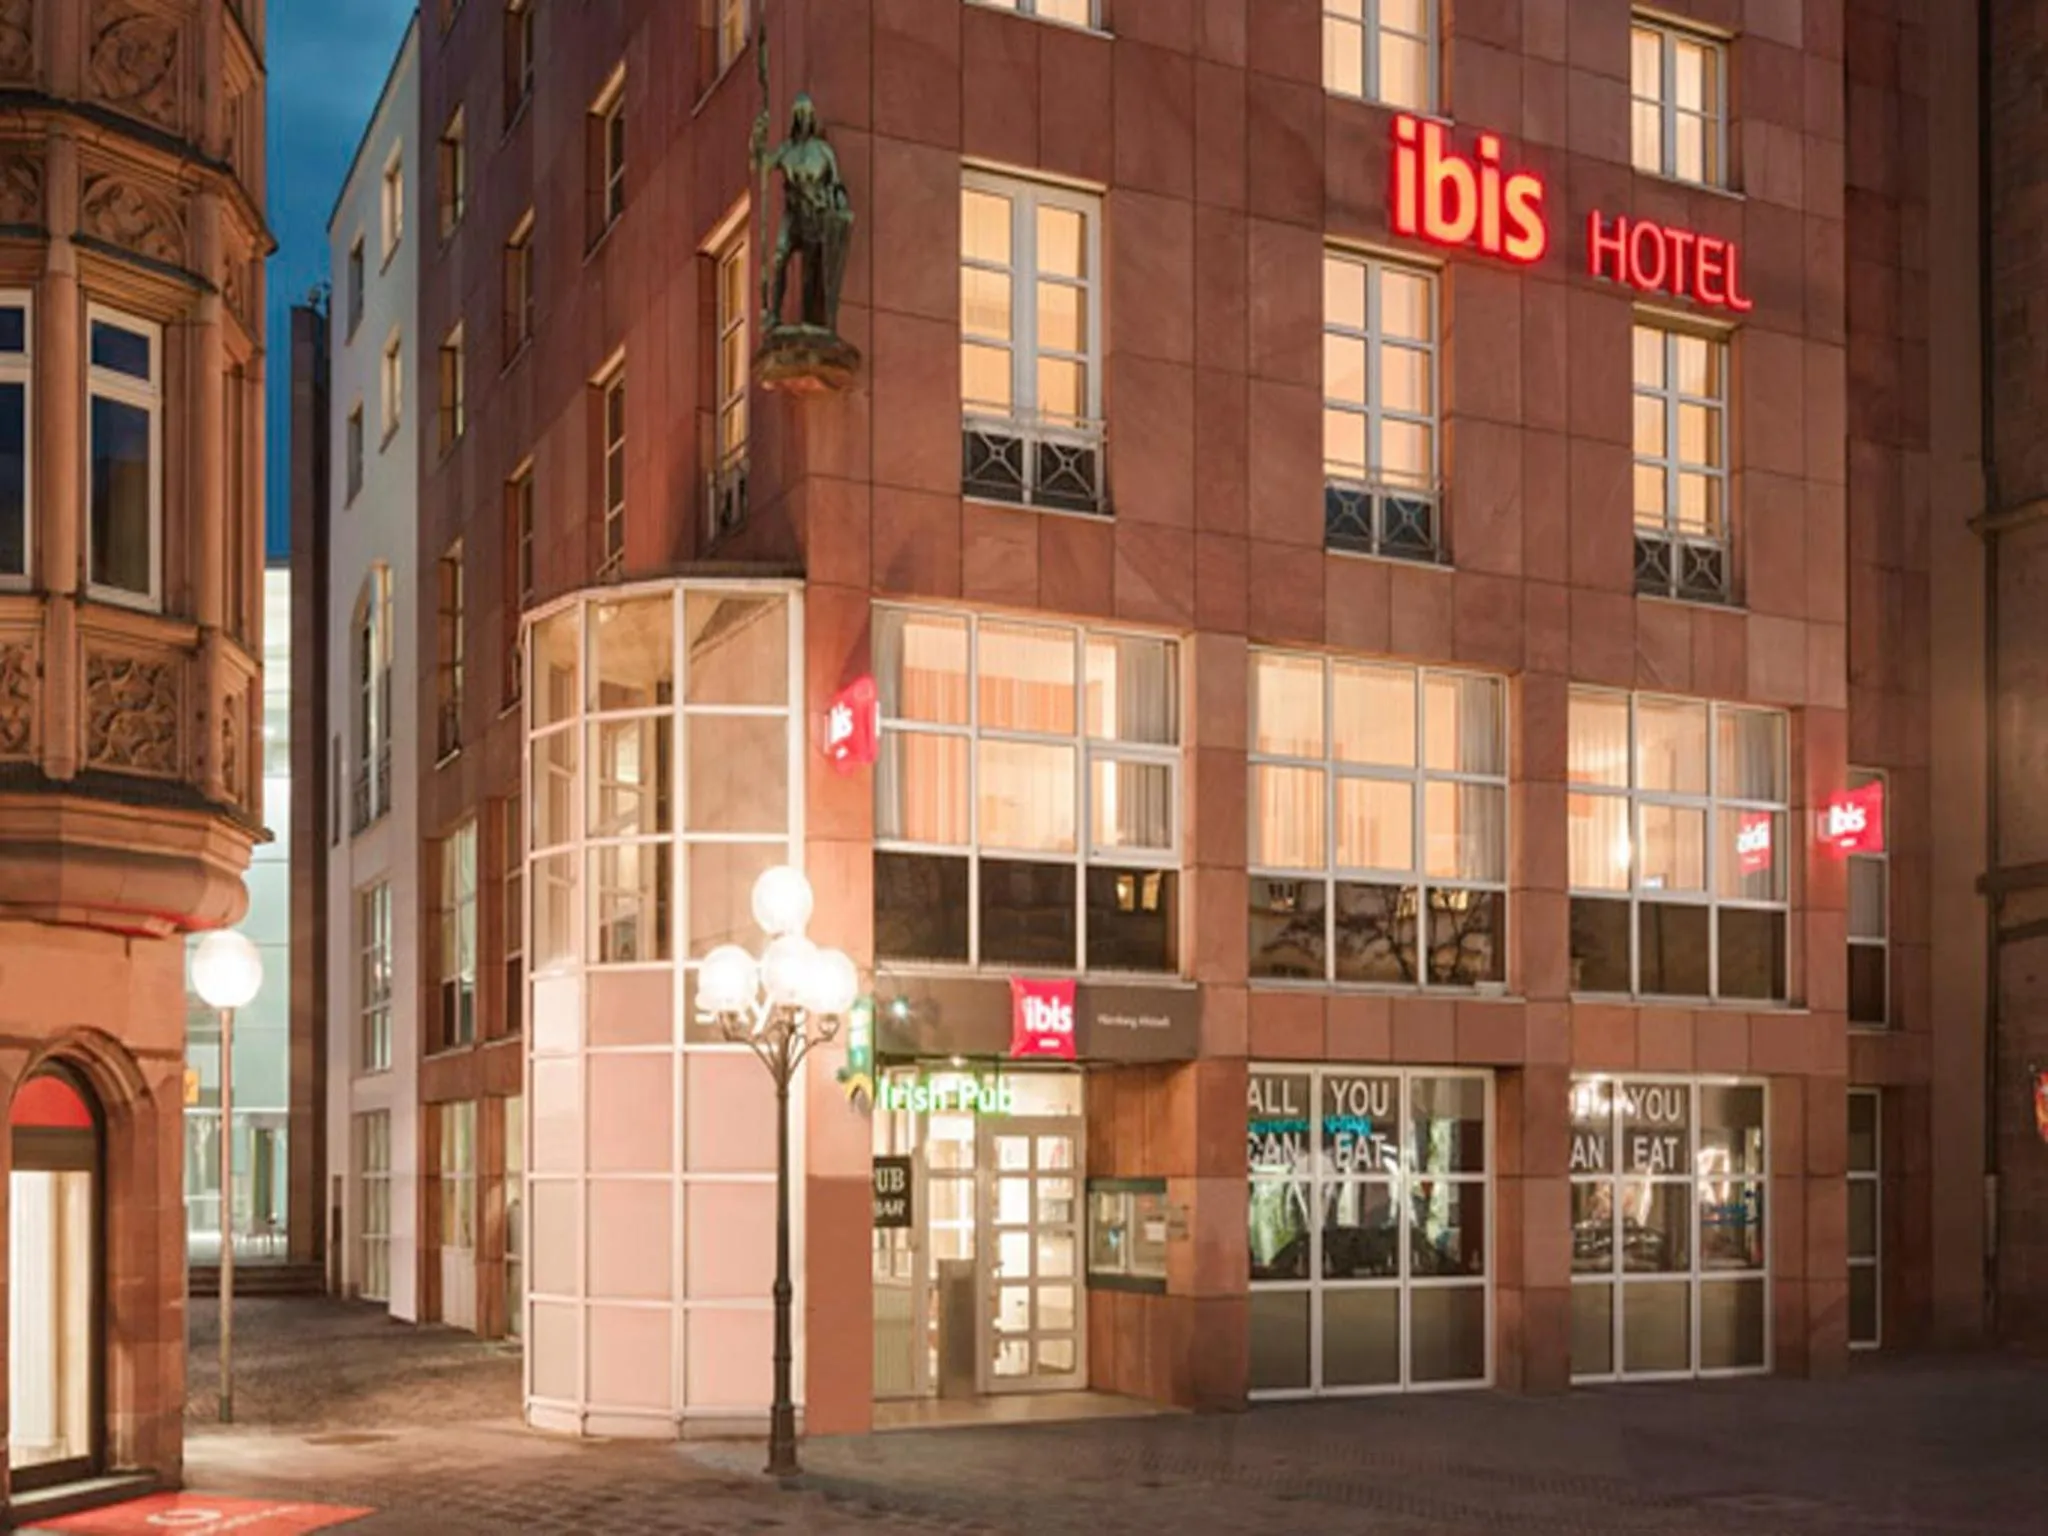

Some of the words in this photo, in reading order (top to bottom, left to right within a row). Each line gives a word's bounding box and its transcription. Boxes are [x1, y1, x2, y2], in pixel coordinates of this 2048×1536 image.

[1393, 113, 1547, 262] ibis
[1590, 208, 1752, 311] HOTEL
[1022, 995, 1073, 1033] ibis
[879, 1074, 947, 1112] Irish
[957, 1074, 1015, 1115] Pub
[1247, 1079, 1299, 1115] ALL
[1331, 1080, 1389, 1117] YOU
[1629, 1087, 1681, 1122] YOU
[1334, 1132, 1387, 1170] EAT
[1569, 1135, 1605, 1169] AN
[1633, 1136, 1679, 1171] EAT
[876, 1167, 905, 1193] UB
